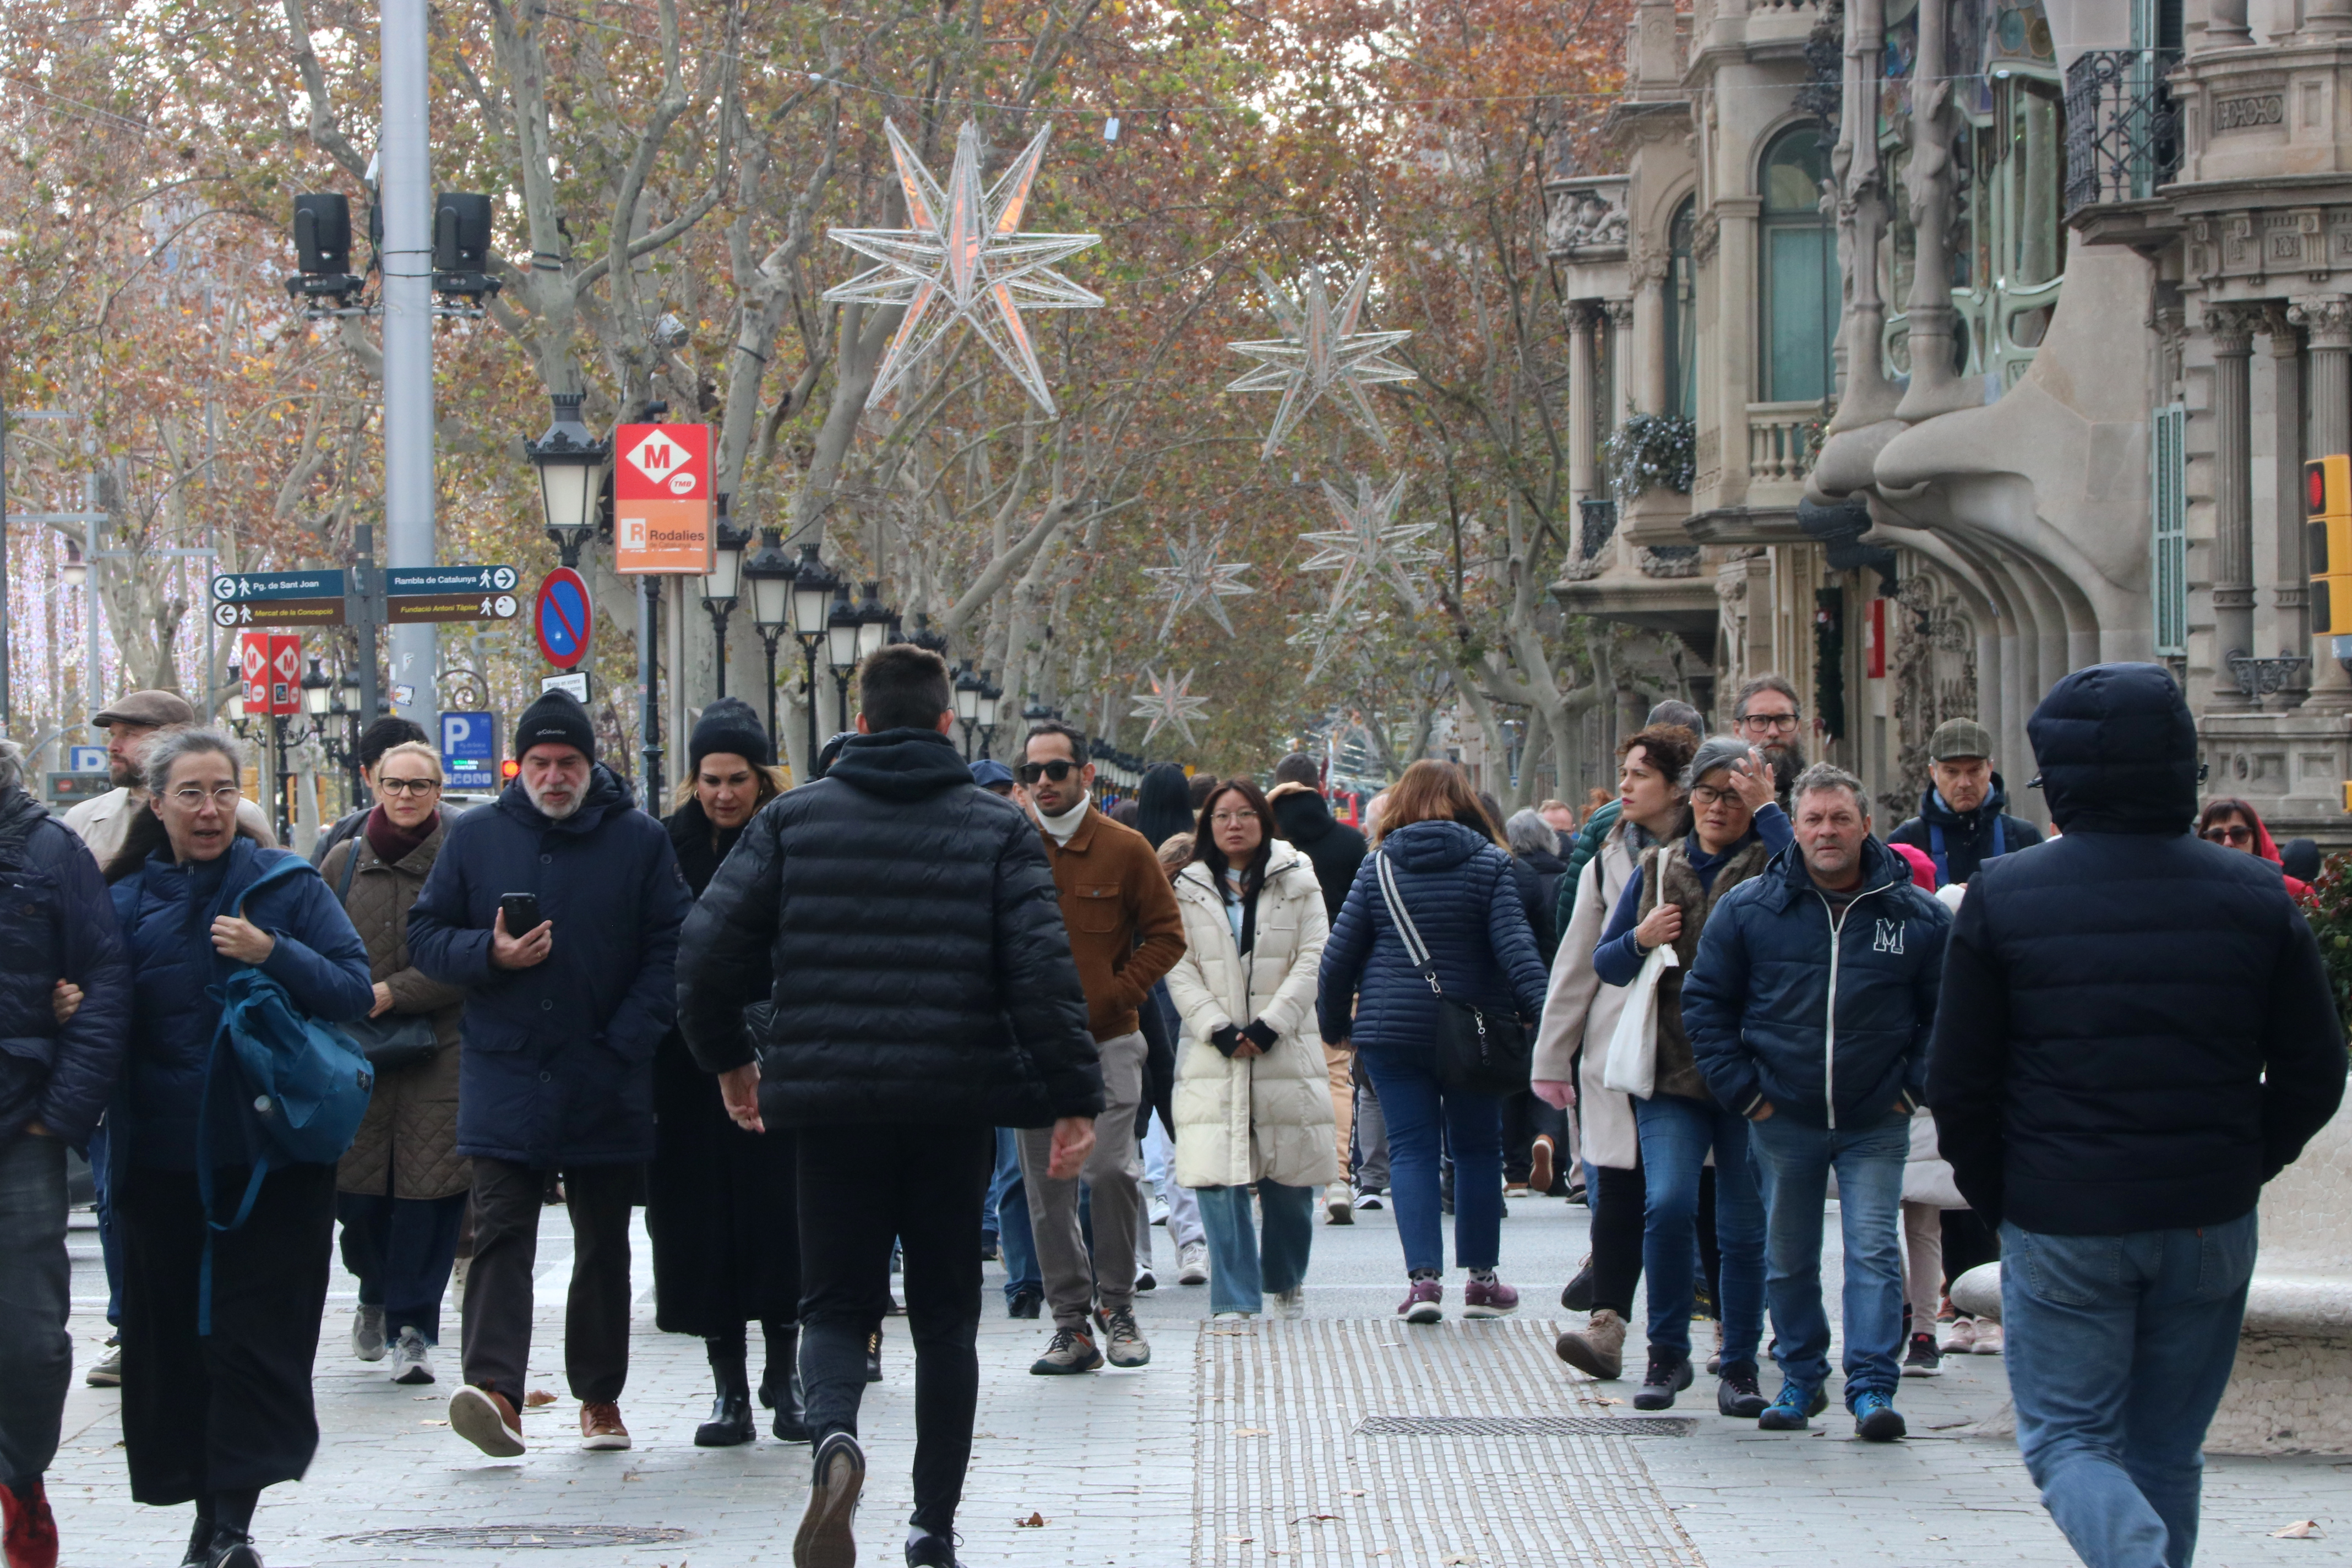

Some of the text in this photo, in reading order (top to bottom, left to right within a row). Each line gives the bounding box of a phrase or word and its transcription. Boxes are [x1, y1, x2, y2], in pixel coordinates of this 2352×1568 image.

[645, 445, 670, 468] M
[630, 524, 645, 541] R
[650, 530, 705, 541] Rodalies
[253, 582, 266, 591] Pg.
[438, 576, 477, 584] Catalunya
[248, 653, 257, 669] M
[283, 655, 294, 671] M
[445, 717, 470, 754] P
[1874, 917, 1905, 954] M
